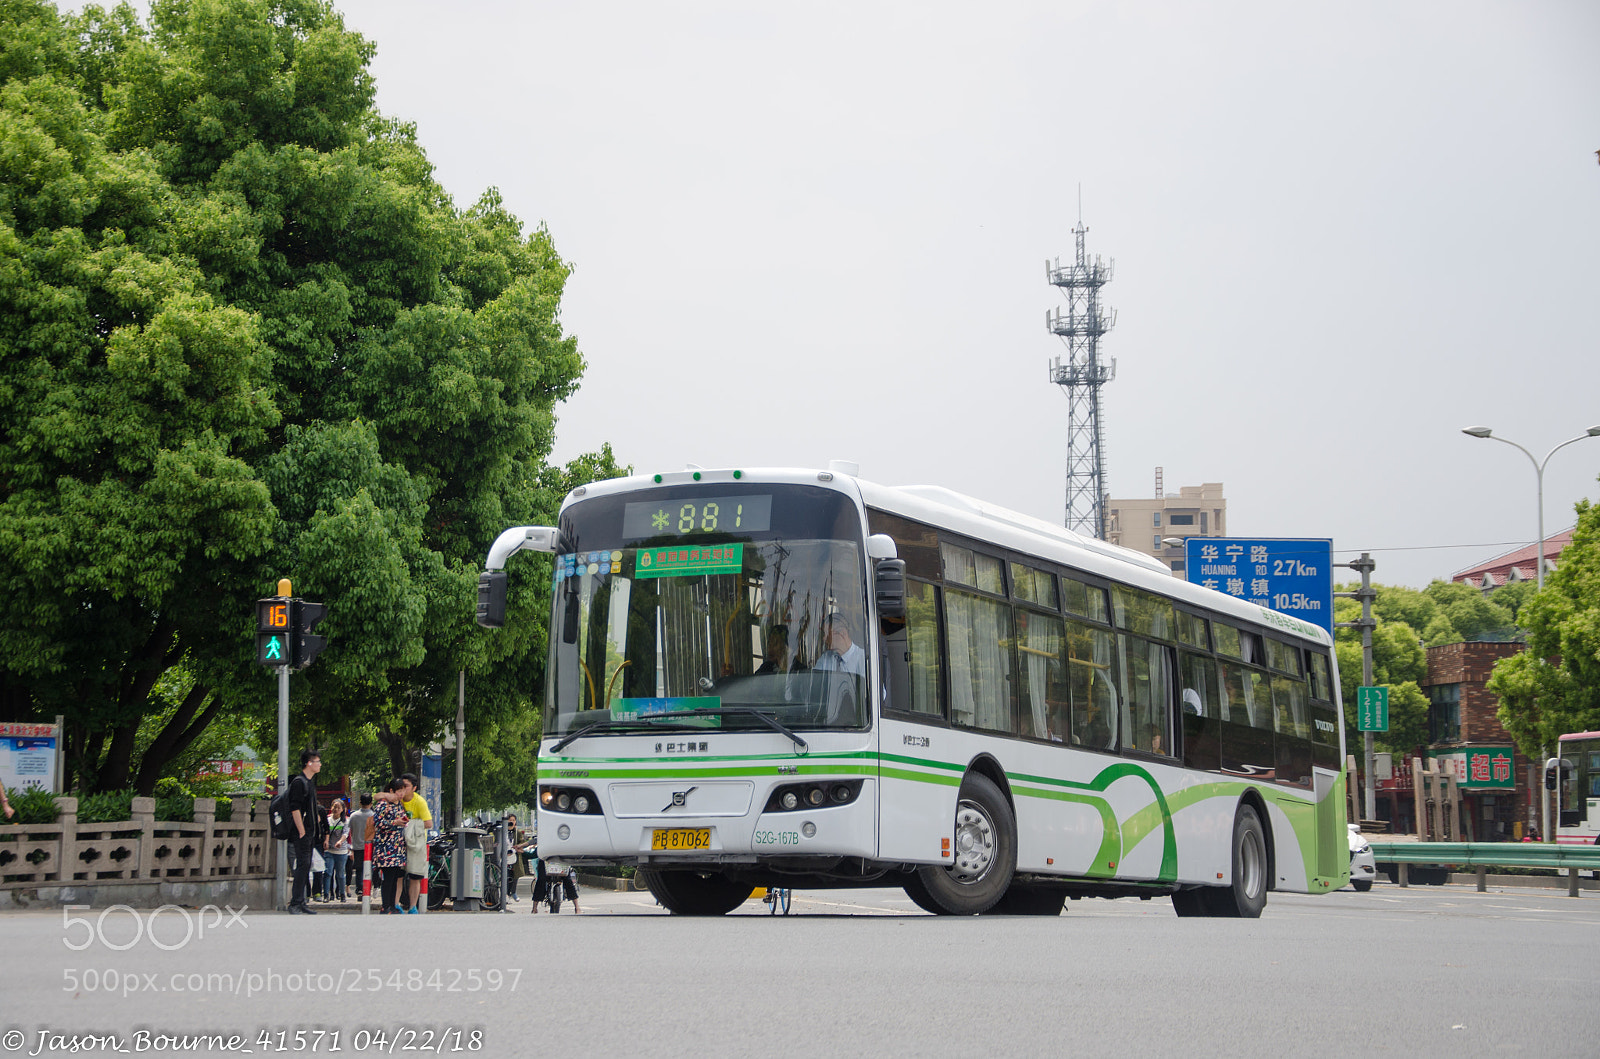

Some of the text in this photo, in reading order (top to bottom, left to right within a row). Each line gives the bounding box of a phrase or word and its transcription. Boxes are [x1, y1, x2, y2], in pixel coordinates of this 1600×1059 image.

[656, 548, 734, 563] 规范服务示范线
[1201, 544, 1269, 563] 华宁路
[1201, 564, 1237, 576] HUANING
[1201, 577, 1269, 596] 车墩镇
[269, 605, 287, 627] 16
[1314, 719, 1339, 733] VOLVO
[1470, 753, 1511, 782] 超市
[755, 831, 799, 845] S2G-167B
